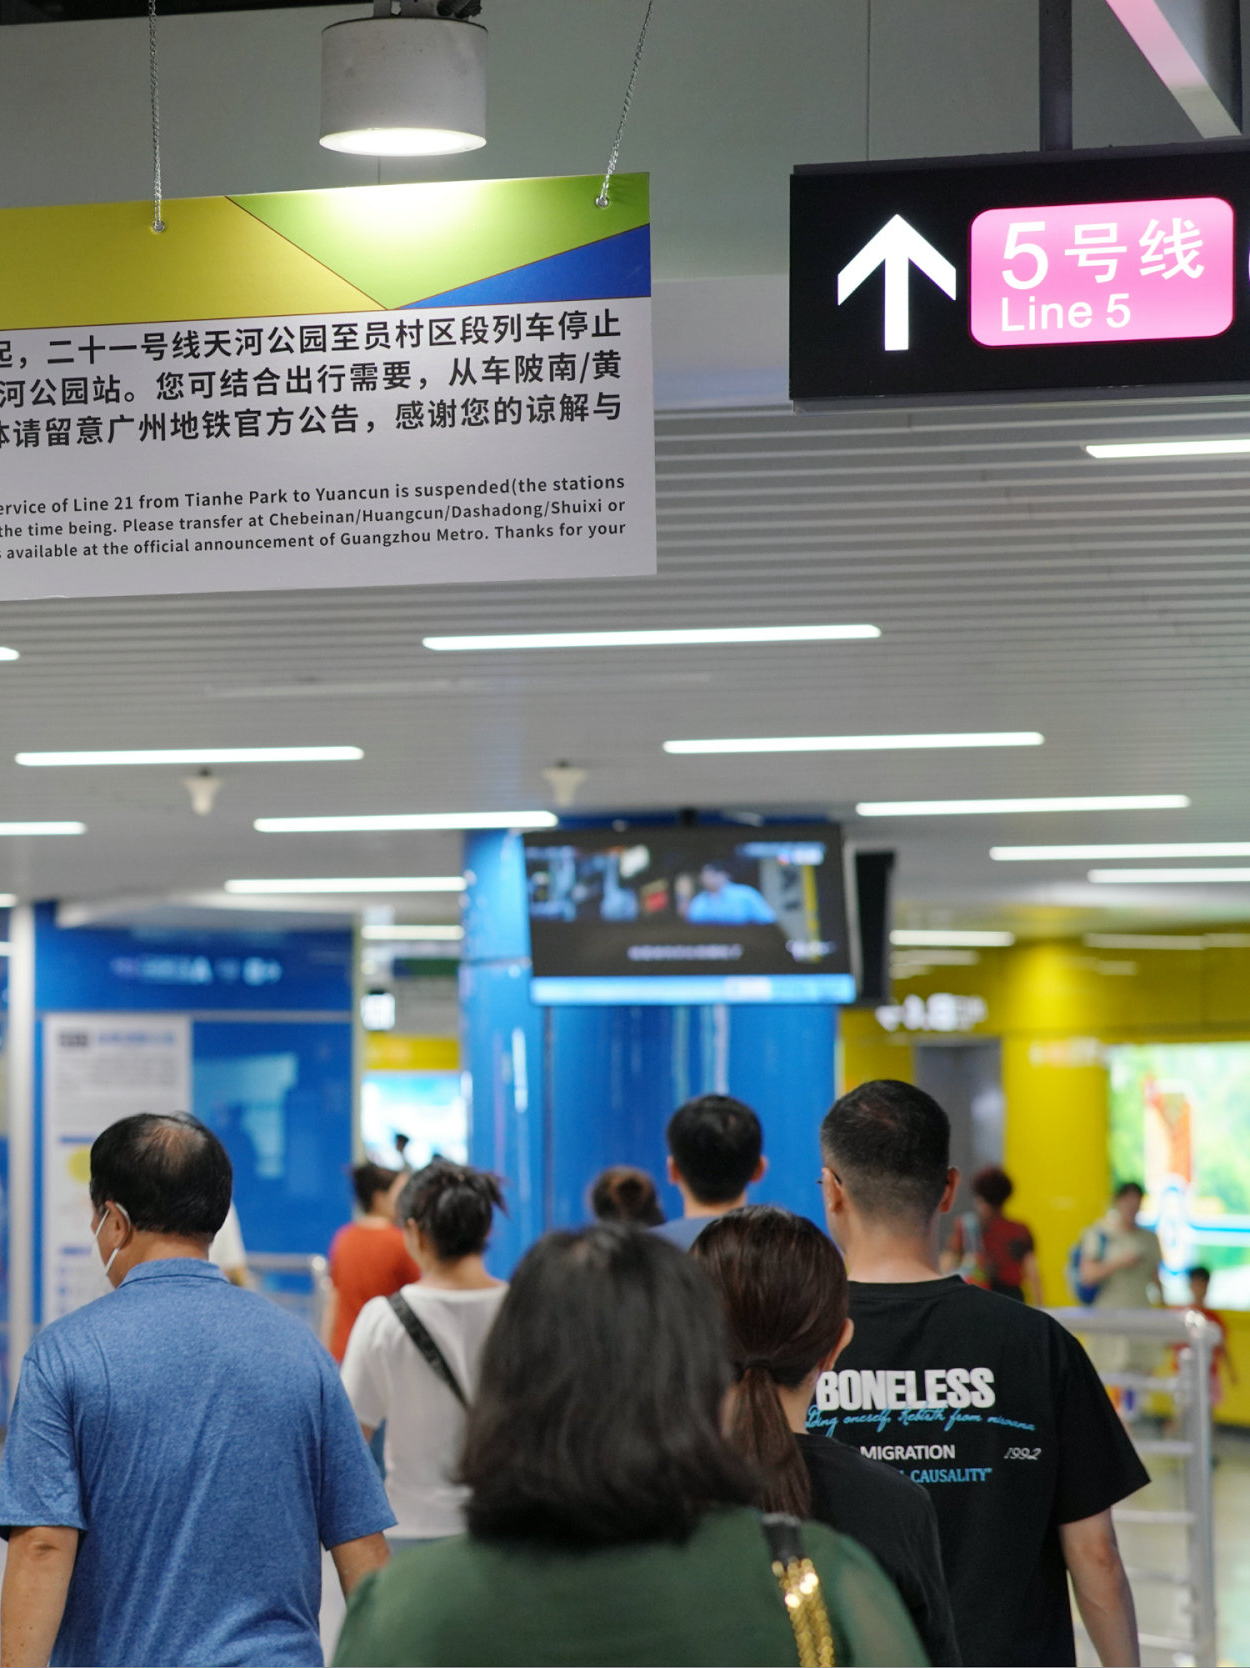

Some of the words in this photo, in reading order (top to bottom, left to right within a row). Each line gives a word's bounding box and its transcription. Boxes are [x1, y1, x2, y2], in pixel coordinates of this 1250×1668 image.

[1001, 216, 1206, 291] 5号线
[1001, 295, 1093, 333] Line
[1105, 292, 1132, 330] 5
[51, 497, 69, 513] of
[73, 496, 109, 512] Line
[114, 495, 133, 511] 21
[138, 493, 179, 509] from
[184, 490, 243, 507] Tianhe
[249, 488, 288, 504] Park
[292, 489, 311, 503] to
[315, 487, 390, 502] Yuancun
[395, 483, 410, 498] is
[552, 474, 625, 491] stations
[27, 522, 63, 537] time
[68, 520, 117, 537] being.
[123, 518, 174, 532] Please
[178, 514, 243, 530] transfer
[248, 514, 264, 527] at
[607, 500, 625, 512] or
[6, 543, 78, 560] available
[82, 543, 98, 556] at
[102, 541, 129, 556] the
[133, 538, 190, 554] official
[194, 534, 315, 552] announcement
[319, 531, 336, 546] of
[340, 529, 431, 548] Guangzhou
[436, 528, 489, 542] Metro.
[494, 523, 554, 539] Thanks
[558, 522, 583, 537] for
[587, 523, 626, 539] your
[815, 1367, 997, 1412] BONELESS
